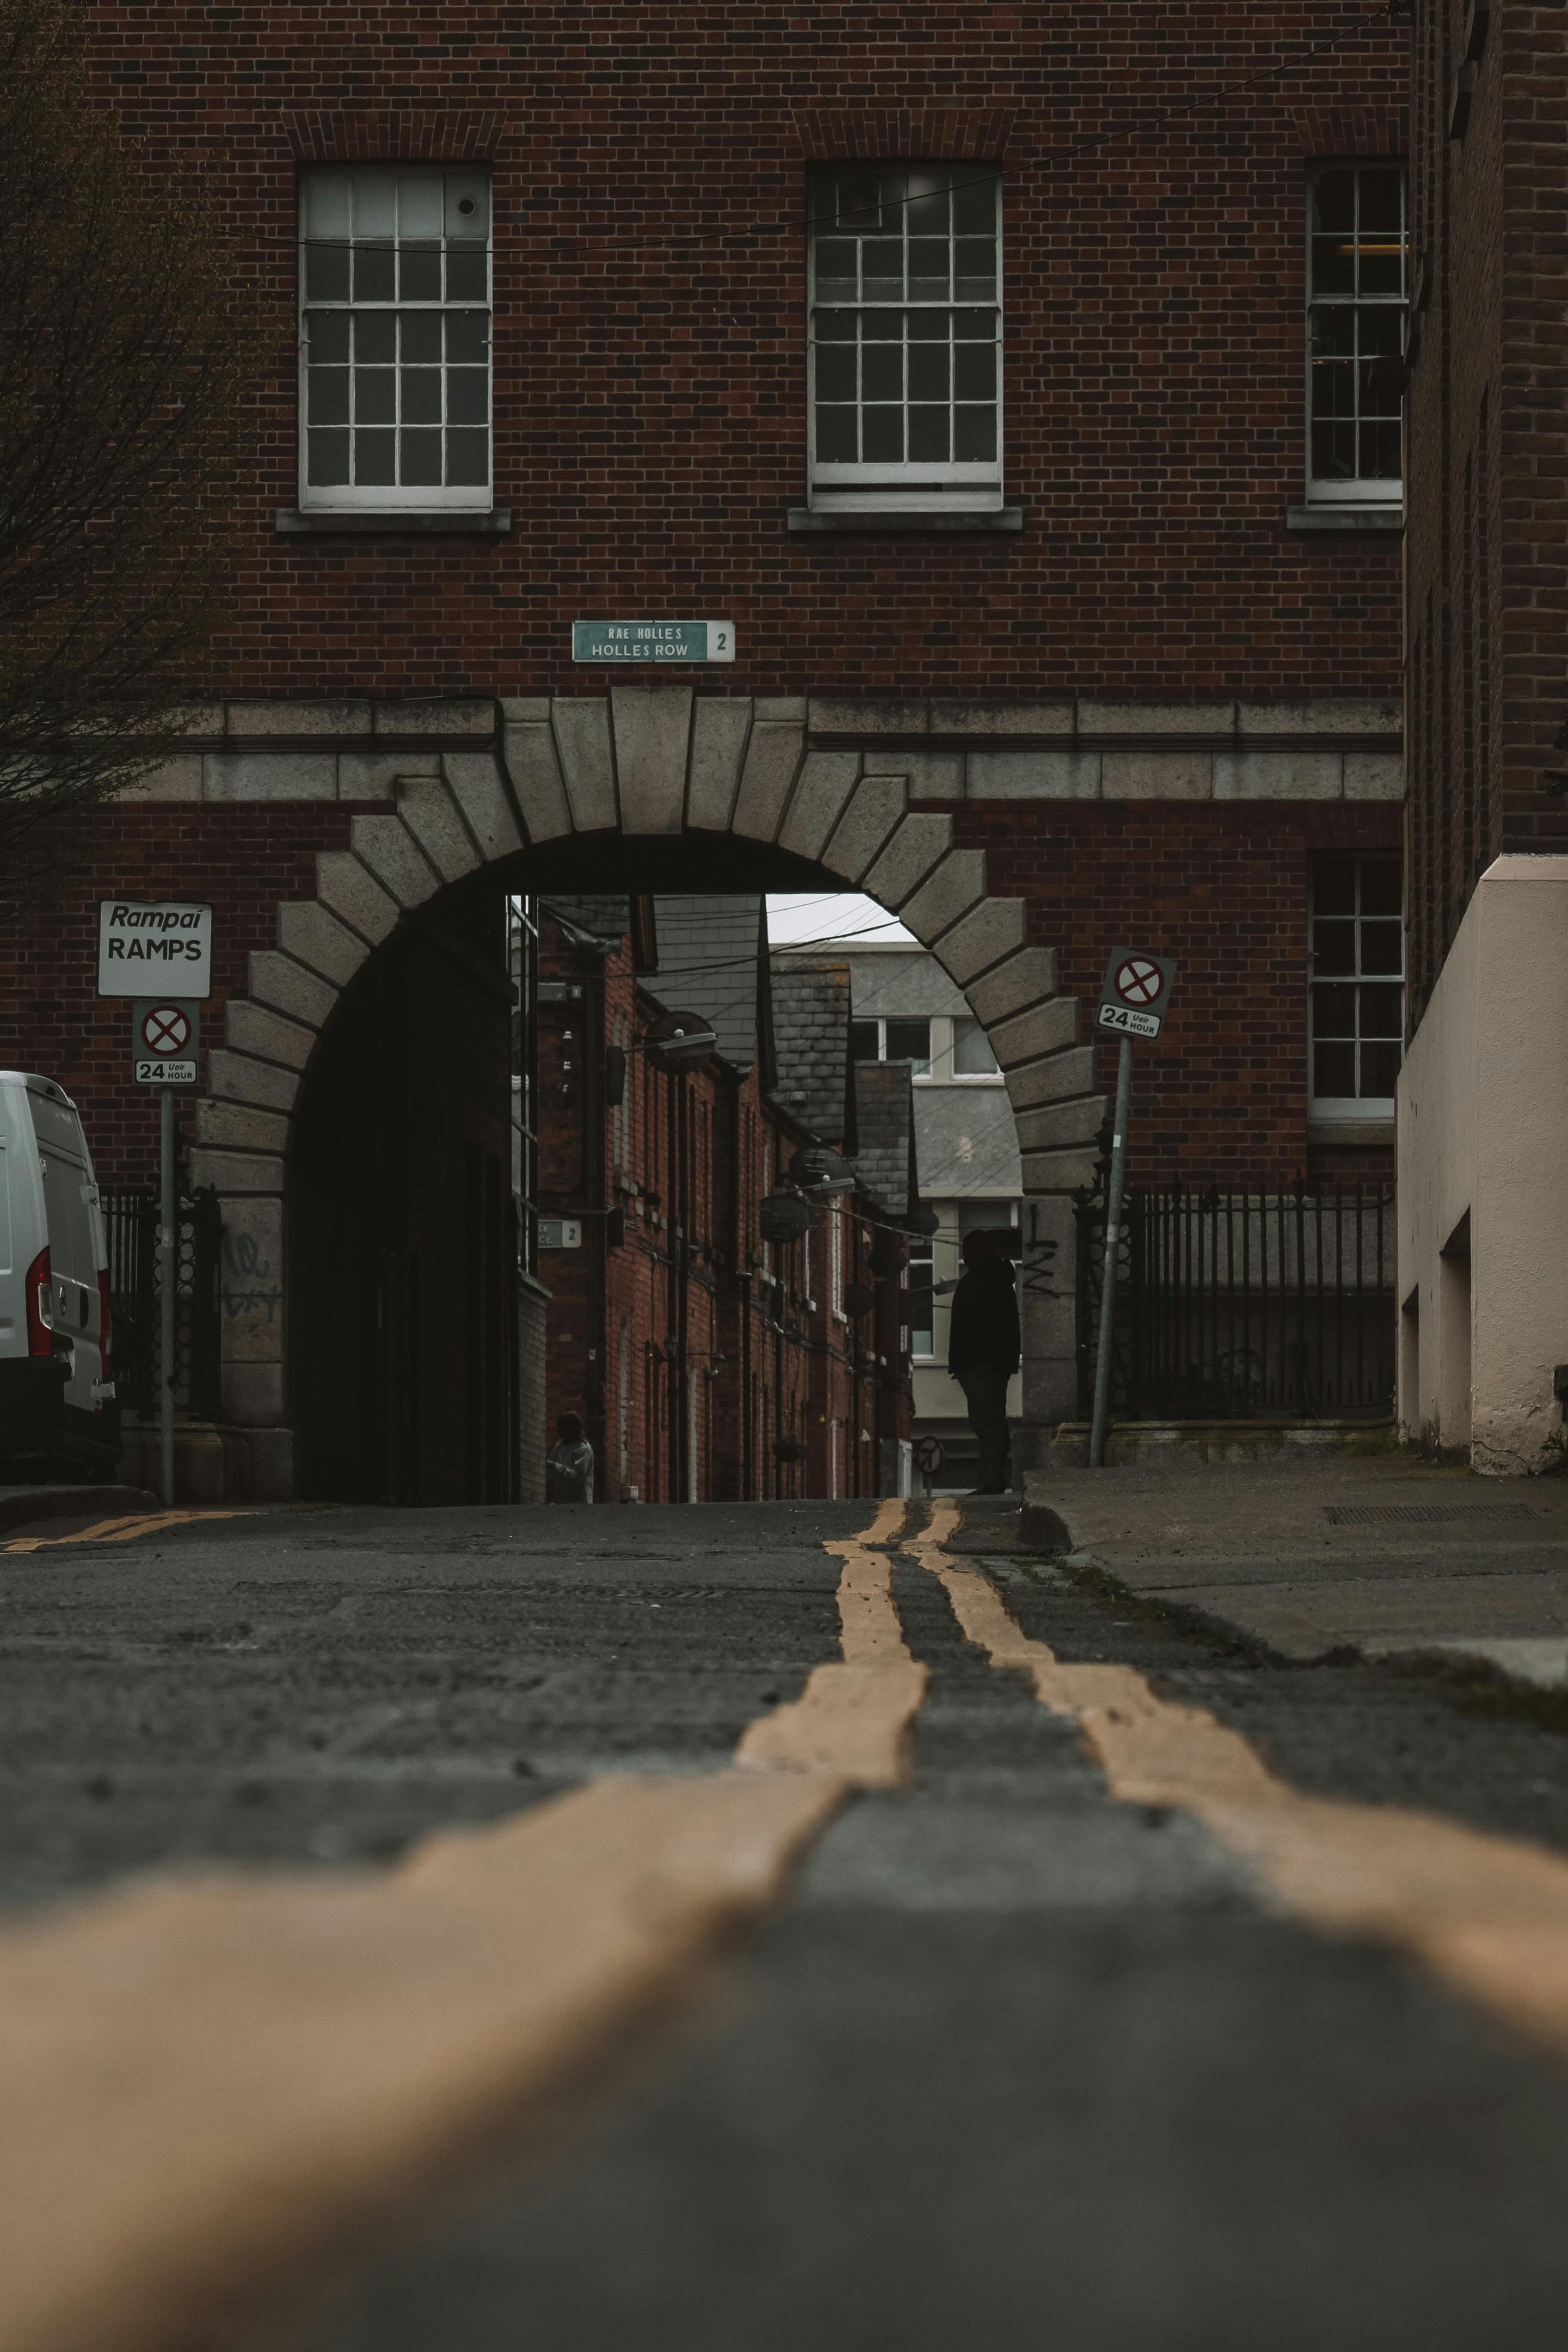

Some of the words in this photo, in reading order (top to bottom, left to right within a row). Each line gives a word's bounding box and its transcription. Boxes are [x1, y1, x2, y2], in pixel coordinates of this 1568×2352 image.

[608, 628, 629, 639] RAE
[637, 628, 681, 640] HOLLES
[717, 633, 727, 650] 2
[592, 644, 649, 656] HOLLES
[655, 644, 688, 656] ROW
[108, 938, 202, 961] RAMPS
[1103, 1008, 1128, 1027] 24
[1133, 1014, 1149, 1023] Uair
[1130, 1022, 1155, 1034] HOUR
[139, 1064, 165, 1079] 24
[569, 1228, 576, 1241] 2
